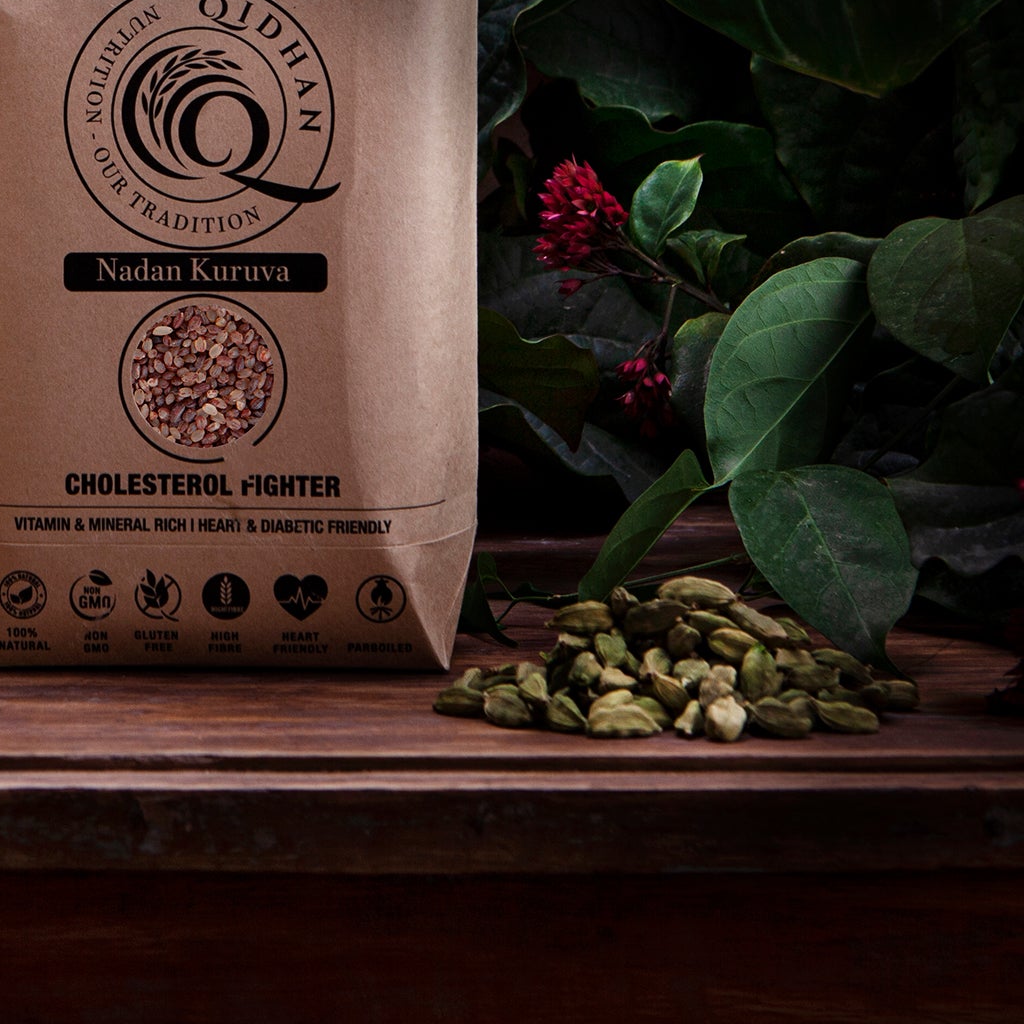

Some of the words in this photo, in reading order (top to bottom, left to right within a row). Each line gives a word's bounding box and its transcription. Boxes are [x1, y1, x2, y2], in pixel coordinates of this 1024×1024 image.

[85, 4, 162, 124] NUTRITION
[93, 146, 129, 195] OUR
[128, 190, 262, 234] TRADITION
[96, 257, 182, 282] Nadan
[189, 257, 291, 283] Kuruva
[65, 473, 233, 496] CHOLESTEROL
[241, 474, 341, 498] FIGHTER
[14, 516, 71, 531] VITAMIN
[74, 518, 85, 532] &
[88, 517, 150, 532] MINERAL
[154, 518, 186, 532] RICH
[198, 518, 241, 533] HEART
[247, 519, 257, 533] &
[261, 519, 324, 534] DIABETIC
[328, 520, 392, 534] FRIENDLY
[83, 586, 101, 595] NON
[78, 595, 111, 609] GMO
[6, 627, 38, 638] 100%
[84, 631, 108, 641] NON
[134, 630, 179, 641] GLUTEN
[211, 631, 239, 641] HIGH
[282, 632, 320, 642] HEART
[83, 643, 110, 653] GMO
[144, 642, 174, 652] FREE
[208, 643, 242, 653] FIBRE
[273, 644, 328, 654] FRIENDLY
[347, 643, 413, 653] PARBOILED
